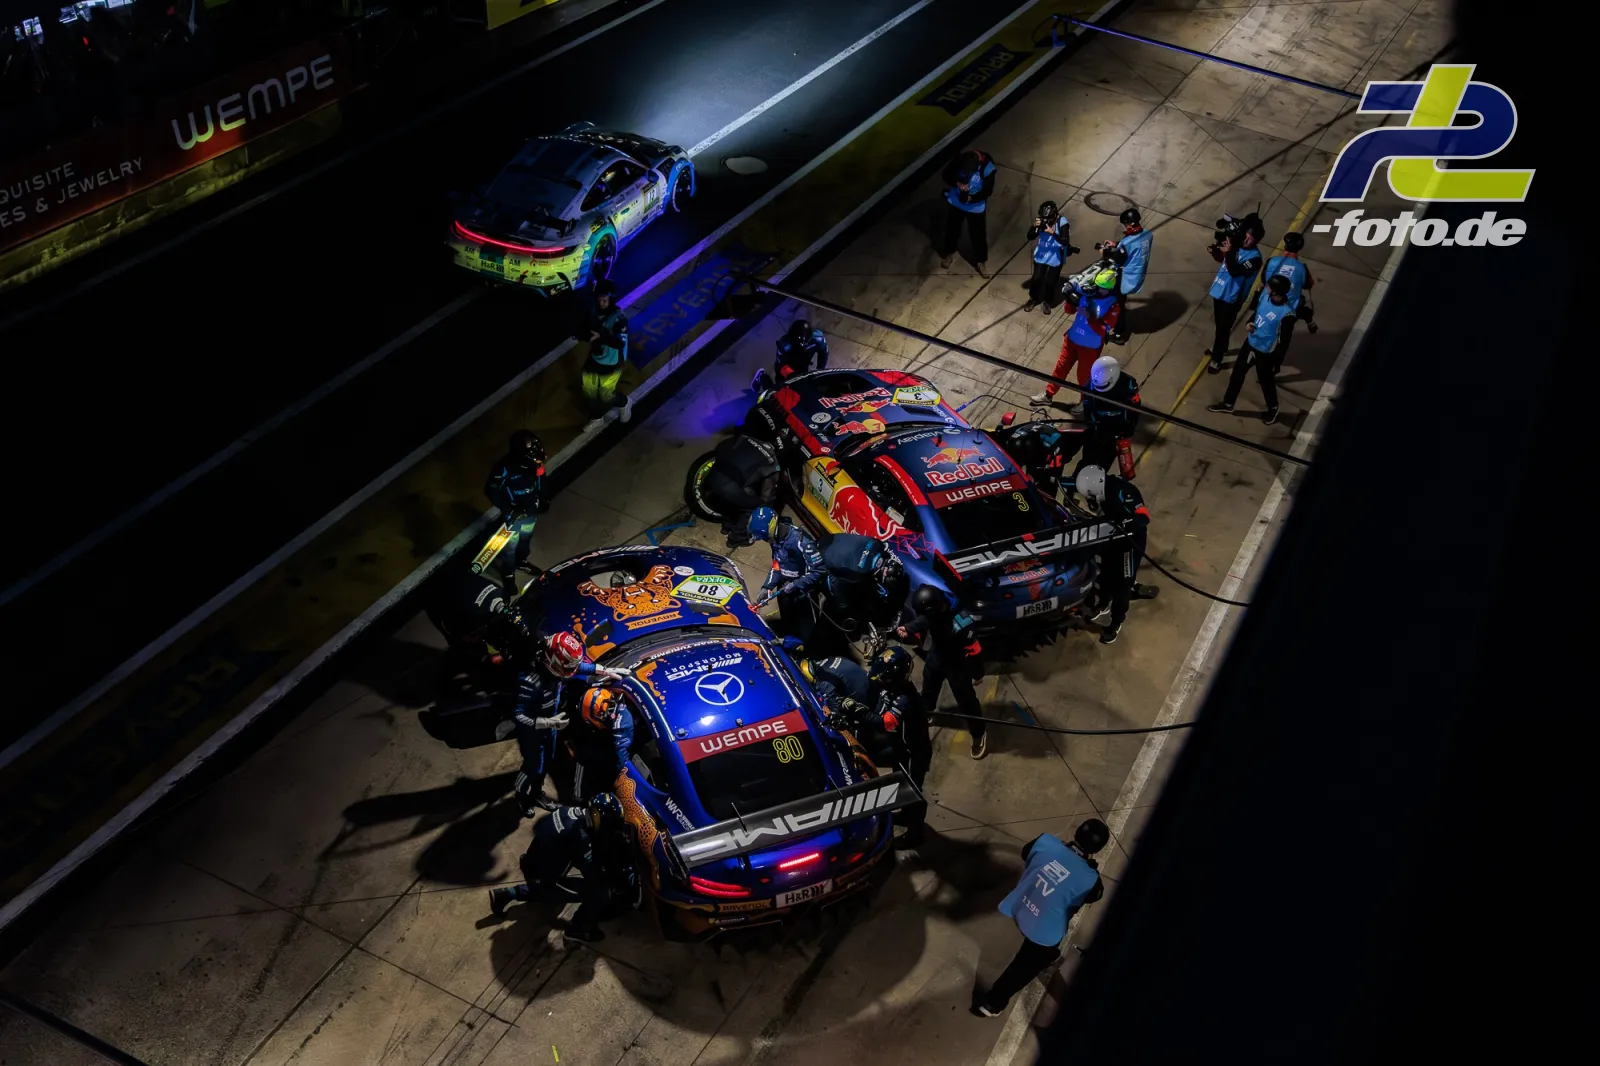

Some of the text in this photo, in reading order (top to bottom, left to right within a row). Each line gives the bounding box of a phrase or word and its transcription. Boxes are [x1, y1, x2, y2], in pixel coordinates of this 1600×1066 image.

[171, 54, 336, 151] WEMPE
[35, 196, 49, 214] &
[56, 156, 145, 205] JEWELRY
[924, 456, 1004, 487] Red Bull
[945, 480, 1012, 502] WEMPE
[1012, 492, 1030, 512] 3
[695, 576, 726, 584] DEKRA
[697, 584, 719, 596] 80
[630, 612, 676, 628] RAVENOL
[663, 651, 741, 676] MOTORSPORT
[700, 720, 788, 753] WEMPE
[772, 735, 805, 763] 80
[1035, 873, 1055, 897] TV
